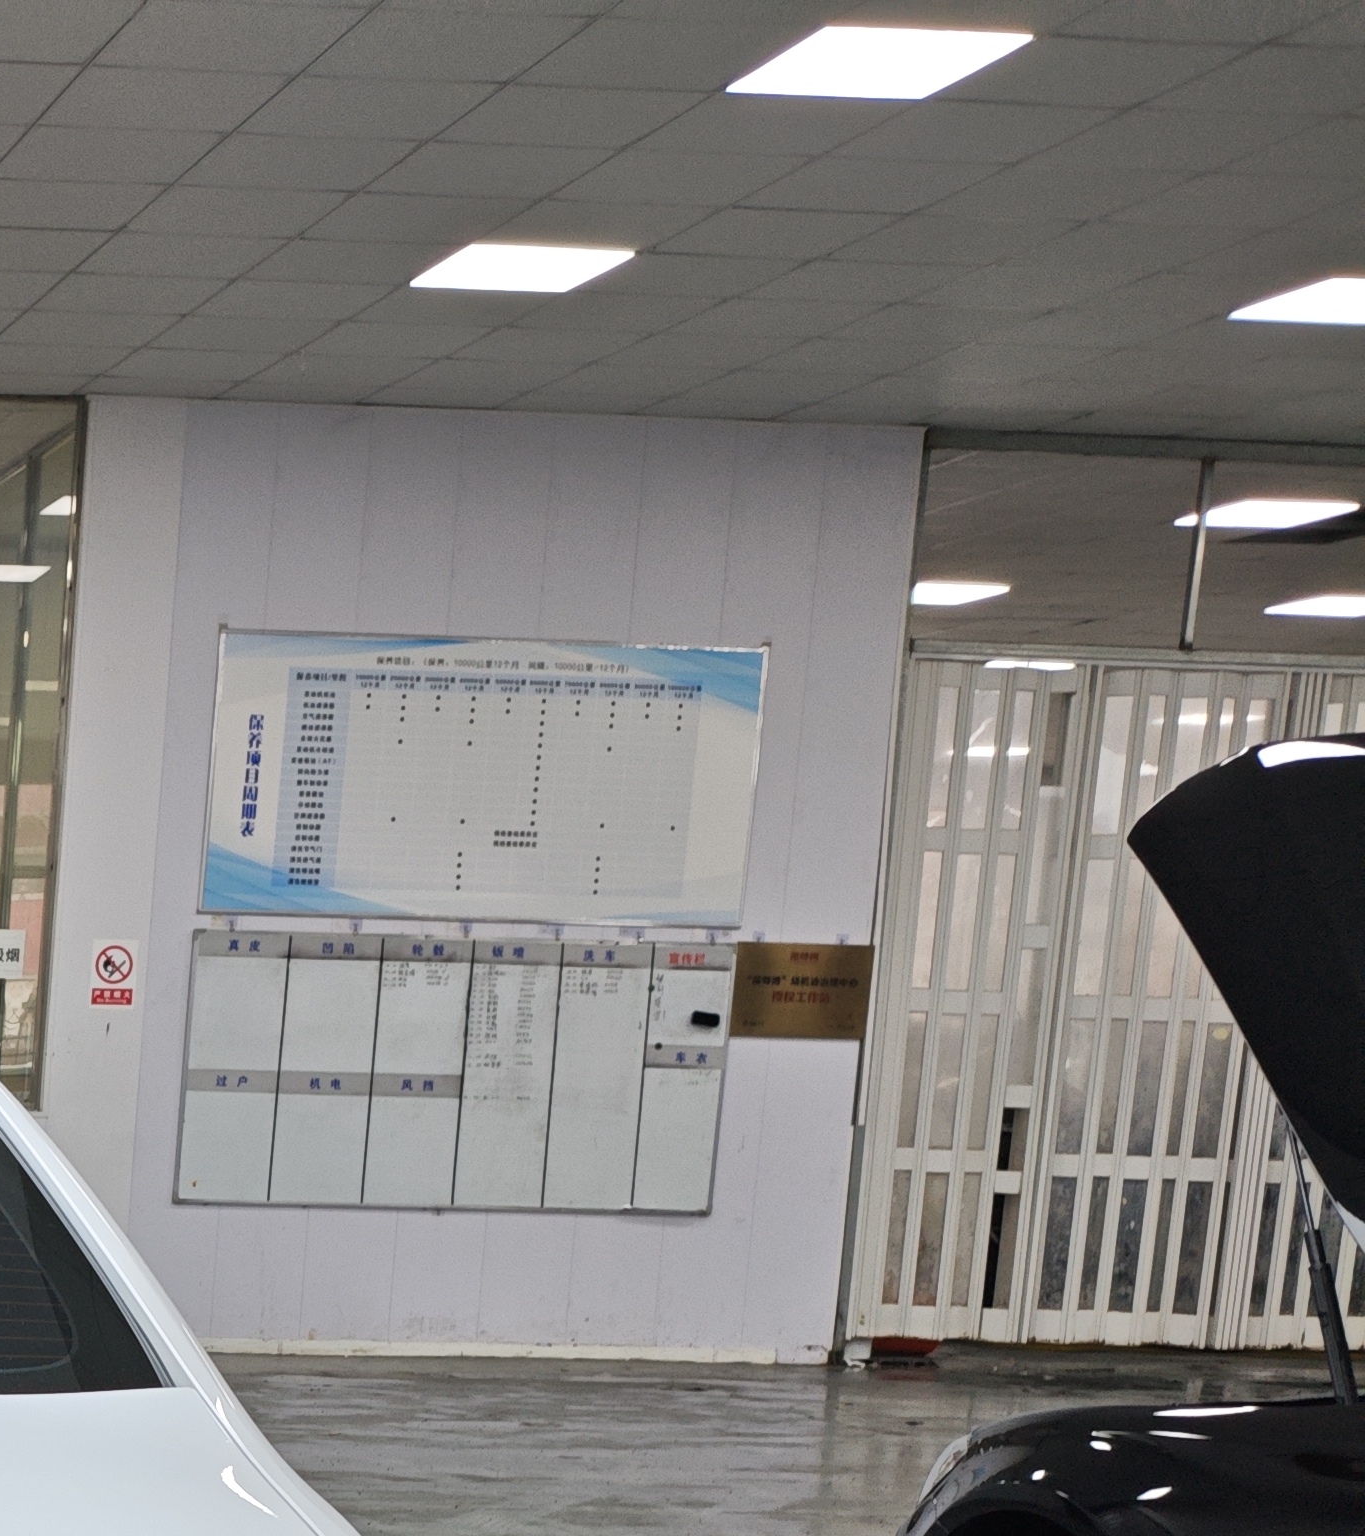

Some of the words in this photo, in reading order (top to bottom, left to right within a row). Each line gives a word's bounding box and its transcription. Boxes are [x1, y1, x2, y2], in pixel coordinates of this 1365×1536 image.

[240, 714, 265, 838] 保养项目周期表
[669, 952, 706, 966] 宣传栏
[216, 1074, 248, 1087] 过户
[310, 1077, 341, 1090] 机电
[401, 1078, 434, 1091] 风挡
